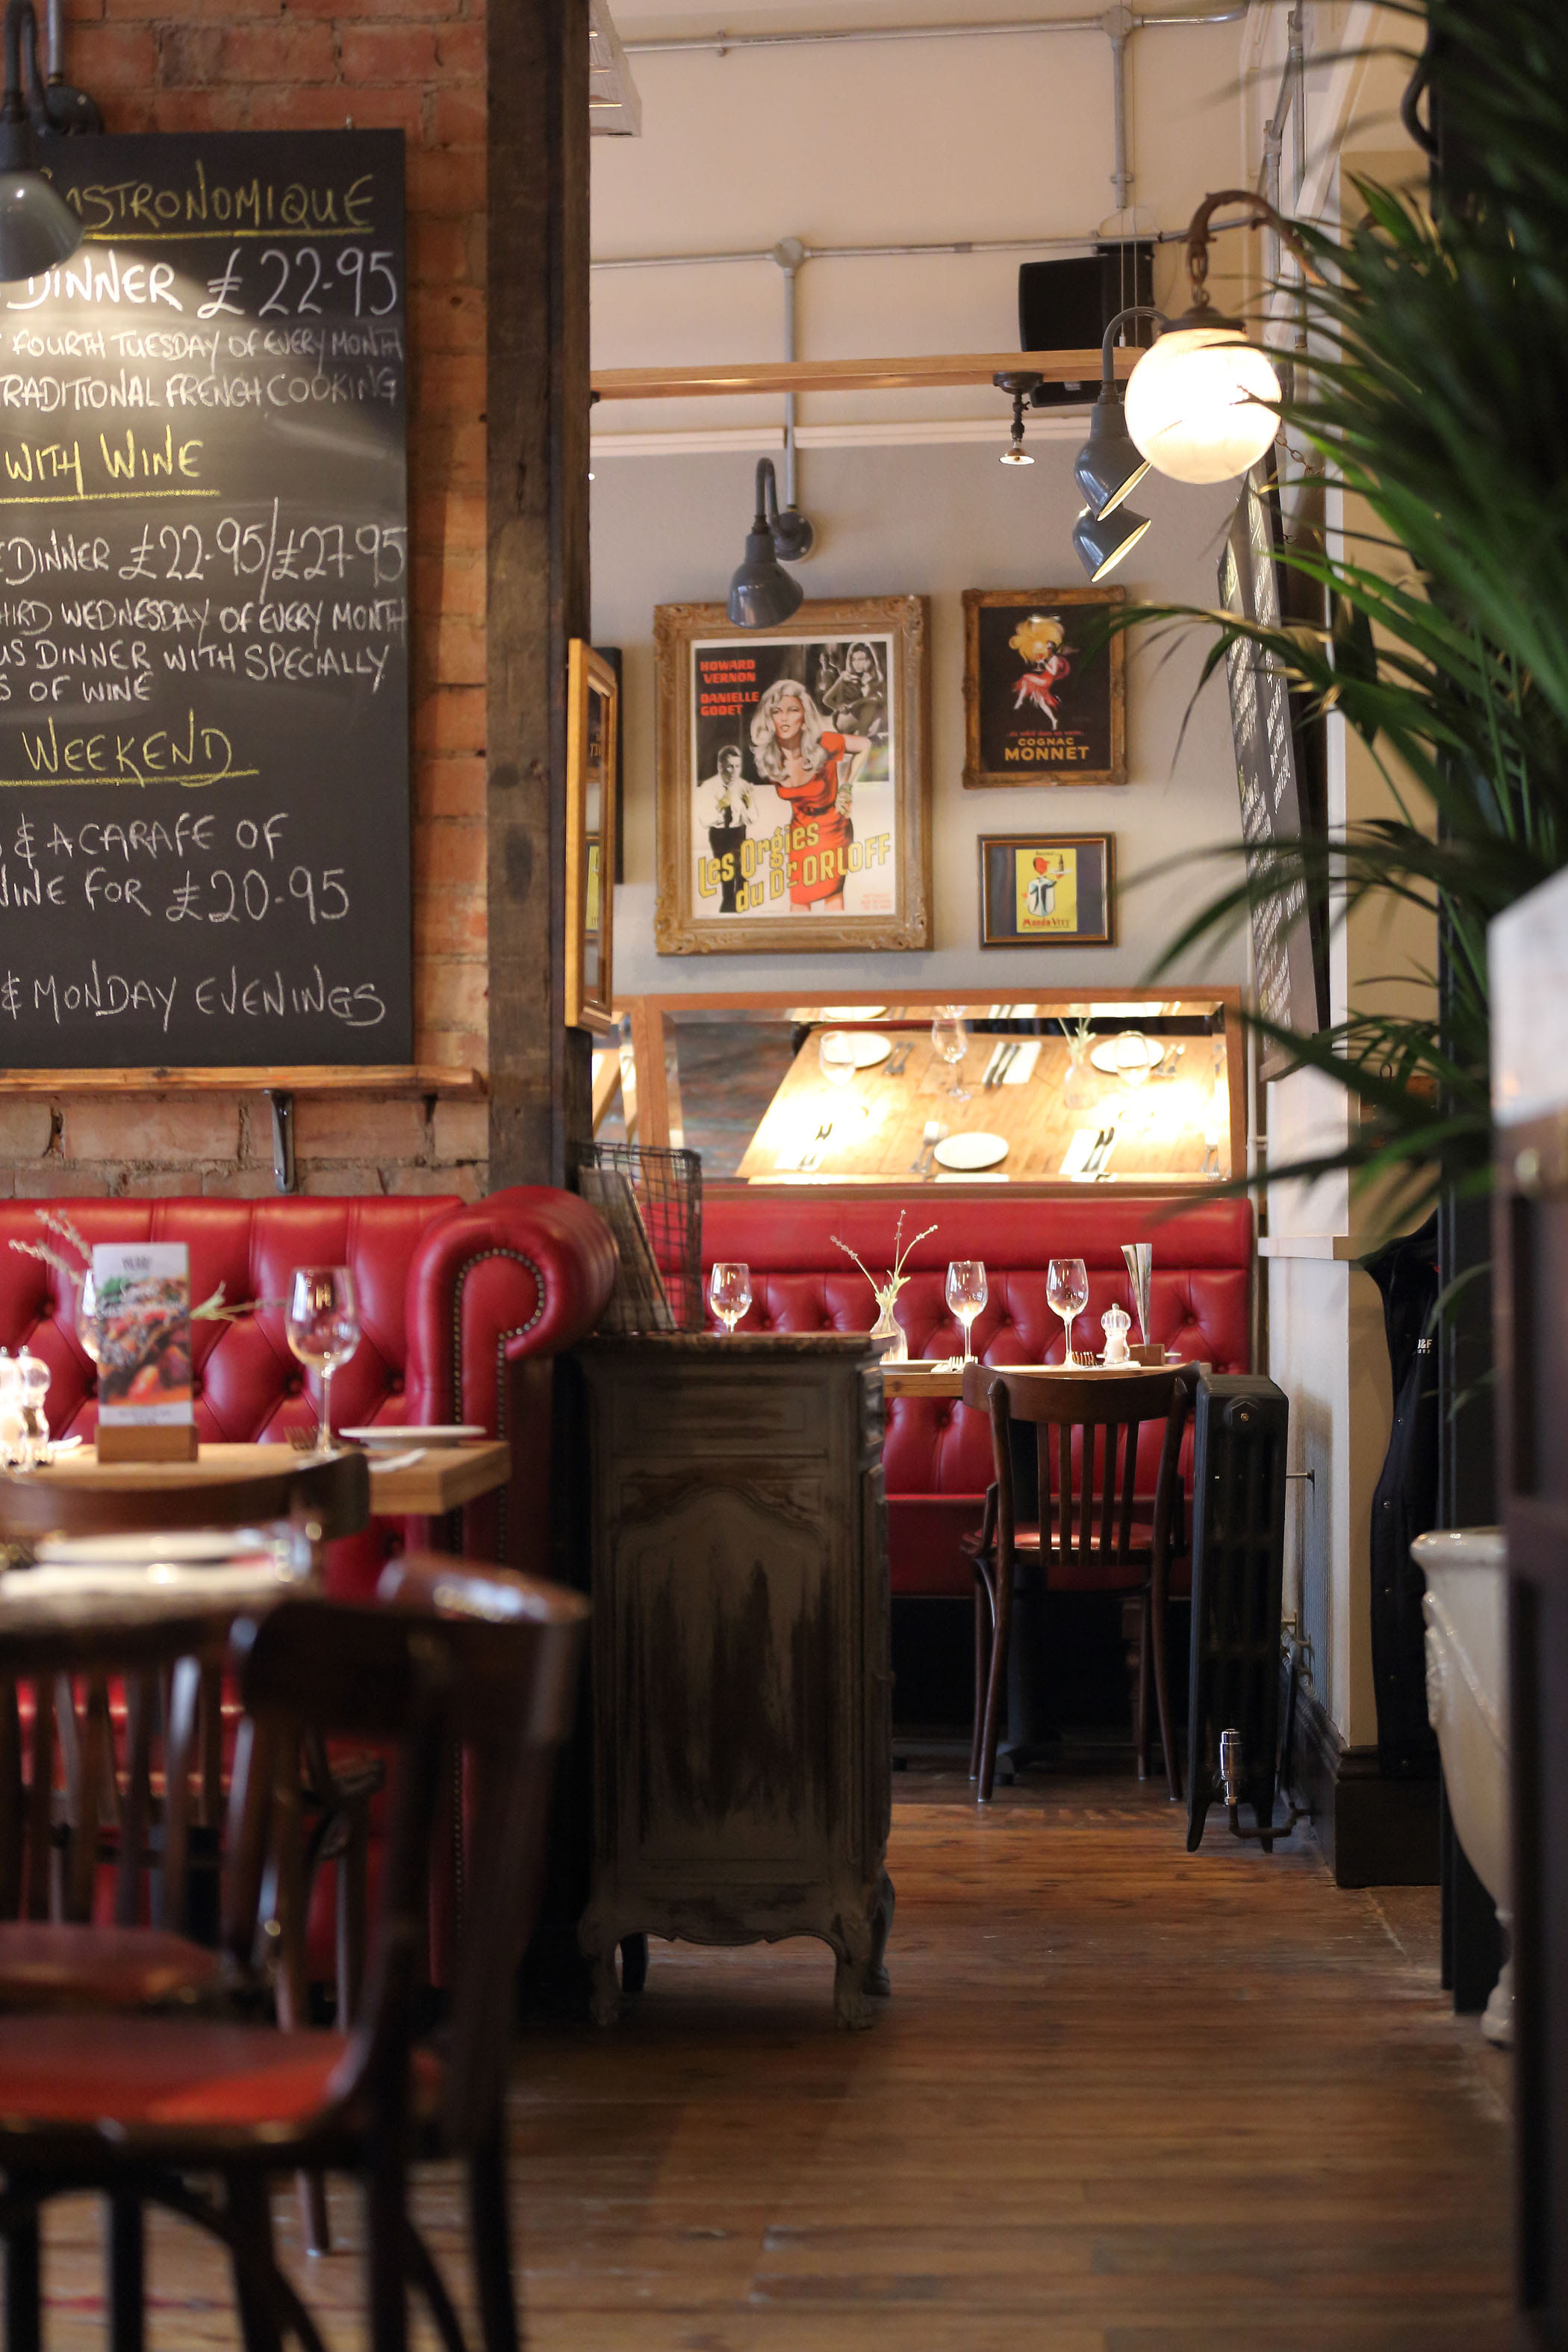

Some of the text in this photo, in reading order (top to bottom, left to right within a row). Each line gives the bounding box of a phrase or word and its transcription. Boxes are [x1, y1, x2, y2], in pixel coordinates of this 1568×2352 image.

[40, 159, 374, 232] ASTRONOMIQUE
[7, 249, 183, 309] DINNER
[12, 326, 403, 376] FOURTH TUESDAY OF EVERY MONTH
[166, 373, 262, 408] FRENCH
[267, 366, 397, 407] COOKING
[4, 424, 203, 498] WITH WINE
[6, 528, 110, 585] DINNER
[61, 598, 210, 651] WEDNESDAY
[220, 602, 255, 633] OF
[260, 600, 323, 650] EVERY
[333, 597, 406, 647] MONTH
[29, 675, 71, 702] OF
[82, 671, 154, 702] WINE
[35, 640, 151, 671] DINNER
[164, 643, 236, 673] WITH
[244, 641, 389, 694] SPECIALLY
[700, 659, 756, 671] HOWARD
[703, 672, 756, 684] VERNON
[700, 691, 759, 703] DANIELLE
[700, 704, 744, 716] GODET
[22, 709, 233, 787] WEEKEND
[1004, 746, 1089, 761] MONNET
[1018, 737, 1074, 747] COGNAC
[78, 812, 215, 862] CARAFE
[236, 812, 289, 861] OF
[697, 822, 820, 899] Les Orgies
[85, 866, 152, 917] FOR
[735, 877, 765, 915] du
[802, 833, 891, 888] ORLOFF
[34, 959, 176, 1033] MONDAY
[196, 965, 386, 1027] EVENINGS
